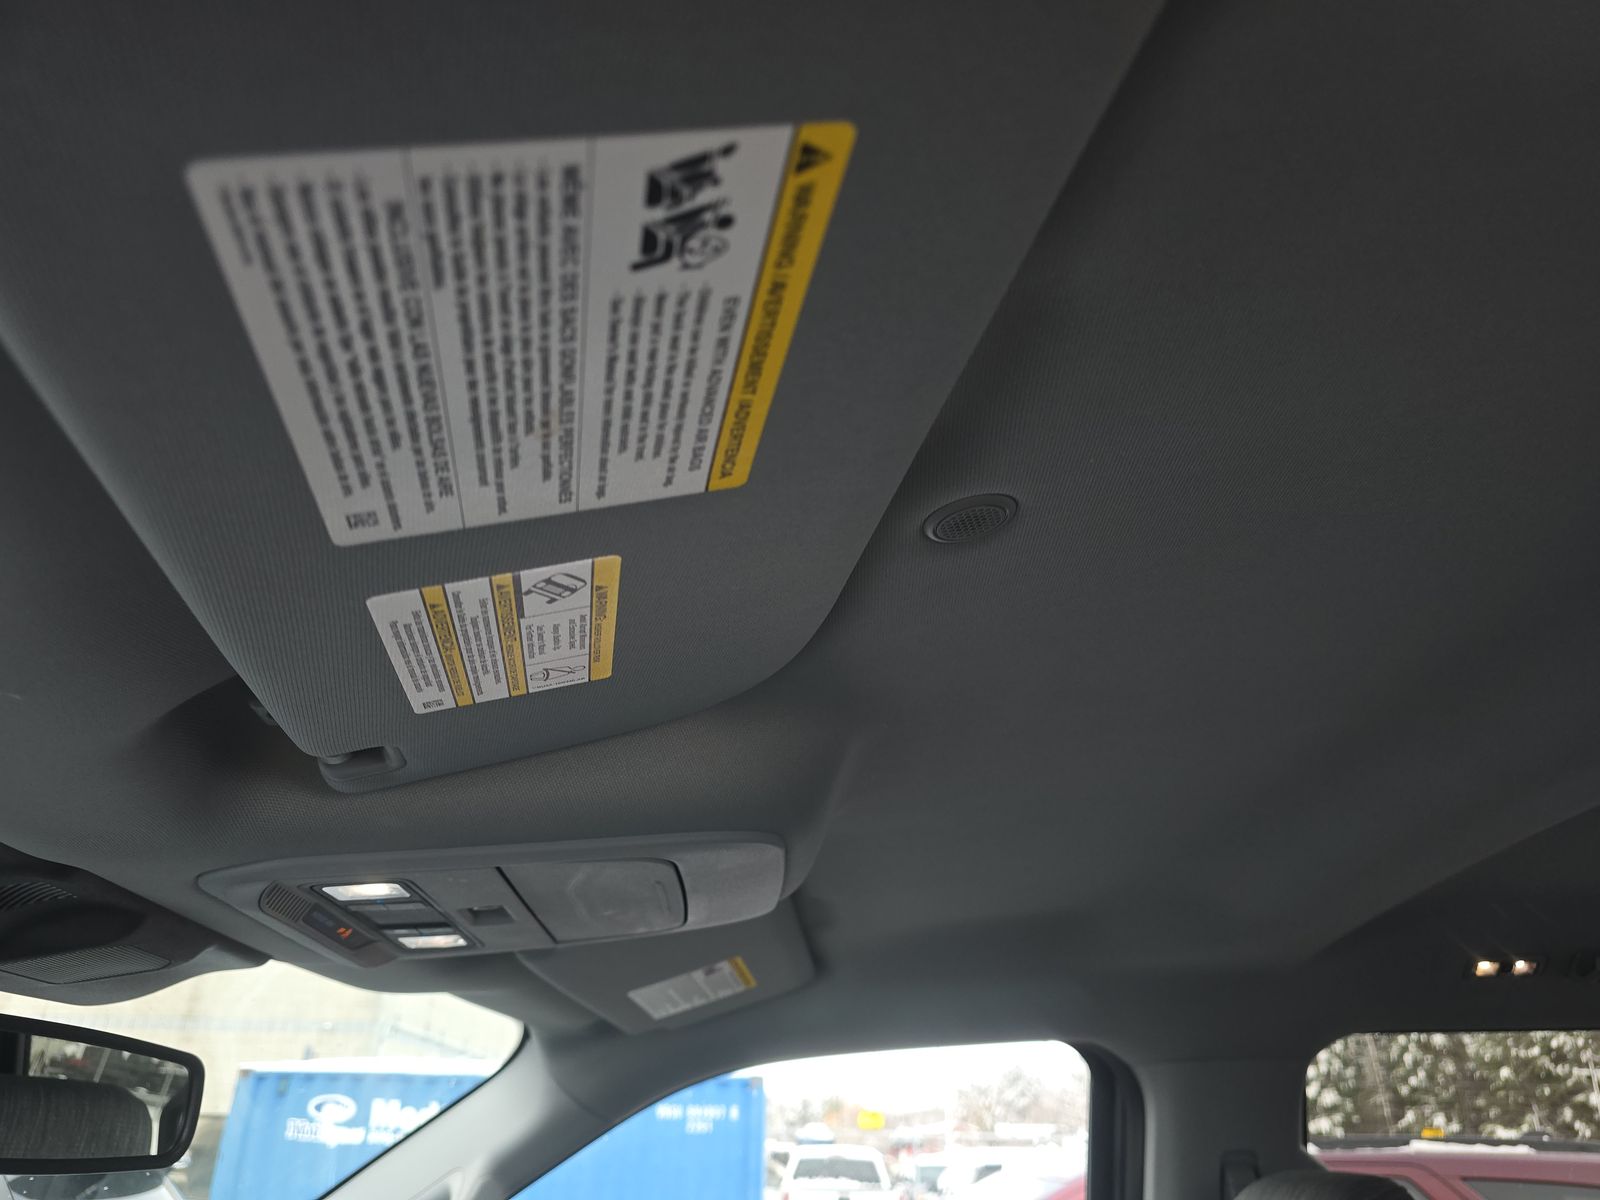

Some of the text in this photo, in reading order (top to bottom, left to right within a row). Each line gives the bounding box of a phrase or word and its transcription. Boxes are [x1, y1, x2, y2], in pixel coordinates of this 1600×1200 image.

[773, 179, 818, 269] WARNING
[716, 295, 742, 333] EVEN
[710, 335, 732, 365] WITH
[697, 367, 724, 426] ADVANCED
[693, 426, 710, 443] AIR
[687, 444, 706, 471] BAGS
